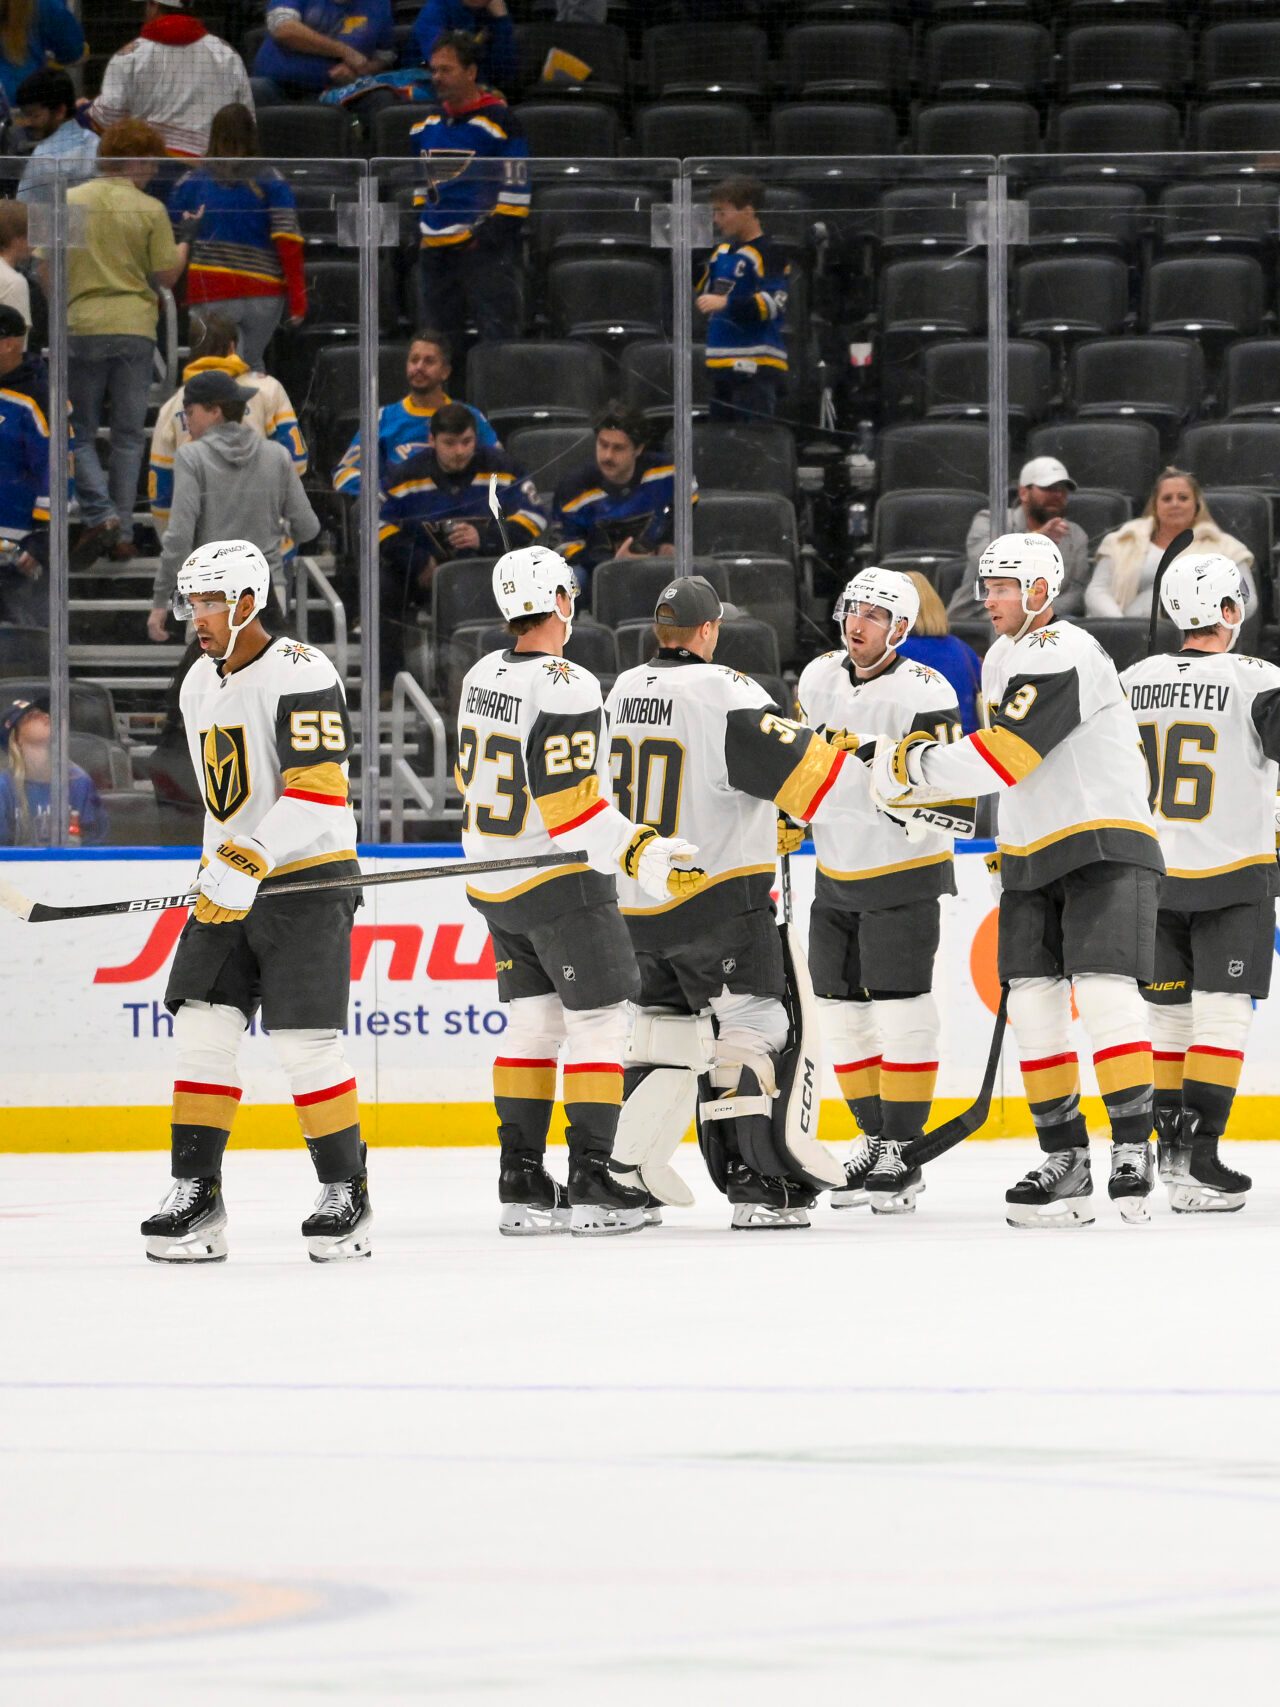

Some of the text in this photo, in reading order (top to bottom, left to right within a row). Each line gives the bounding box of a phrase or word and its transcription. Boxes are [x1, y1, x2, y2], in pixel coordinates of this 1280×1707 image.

[502, 580, 516, 595] 23
[853, 584, 875, 593] CCM
[1169, 598, 1181, 611] 16
[615, 697, 673, 726] LINDBOM
[1004, 682, 1038, 721] 3
[290, 710, 347, 752] 55
[543, 730, 598, 777] 23
[911, 807, 974, 836] CCM
[216, 843, 261, 878] AUER
[127, 894, 198, 913] BAUE
[714, 1105, 733, 1113] CCM
[800, 1056, 816, 1135] CCM
